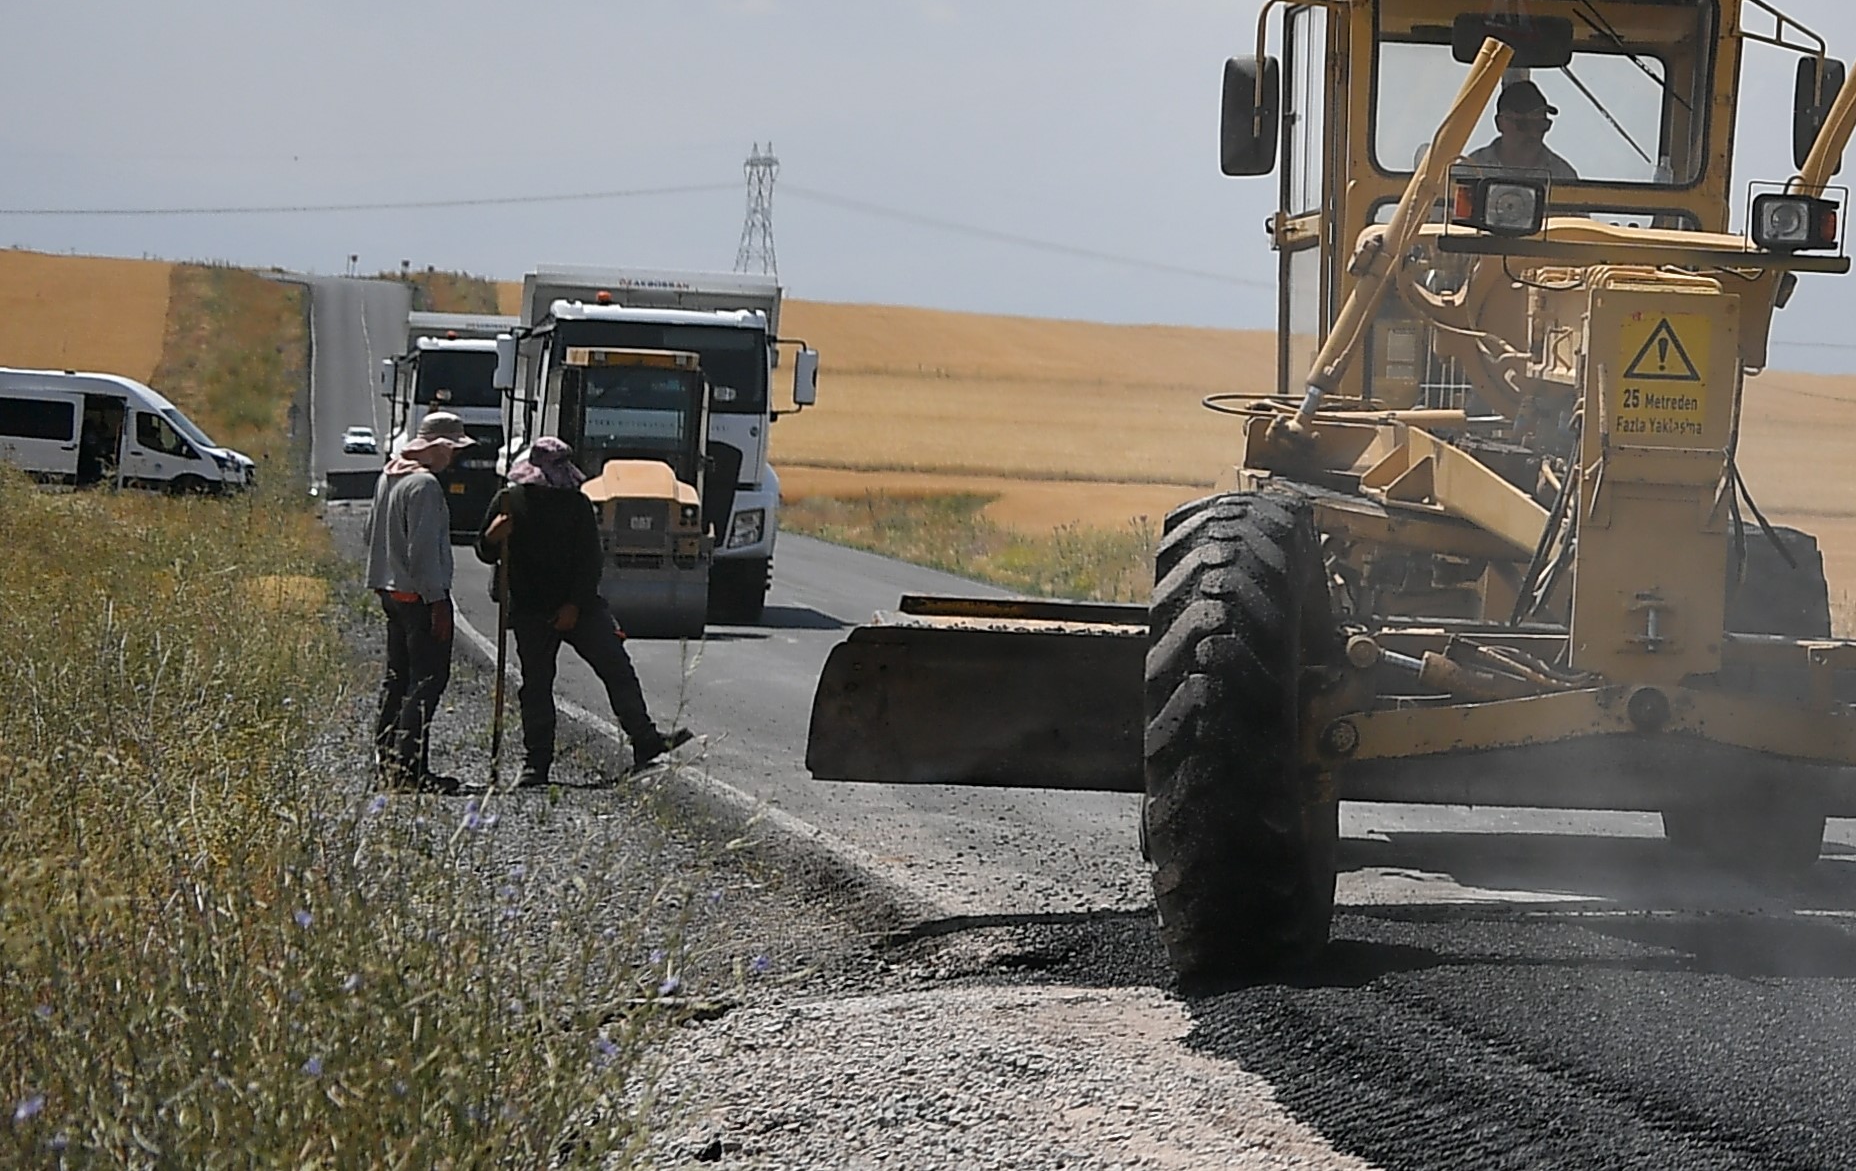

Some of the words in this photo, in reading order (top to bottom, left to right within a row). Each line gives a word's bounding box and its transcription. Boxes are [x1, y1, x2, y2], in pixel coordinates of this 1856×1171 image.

[1623, 388, 1640, 409] 25
[1644, 392, 1698, 411] Metreden
[1616, 415, 1646, 433] Fazla
